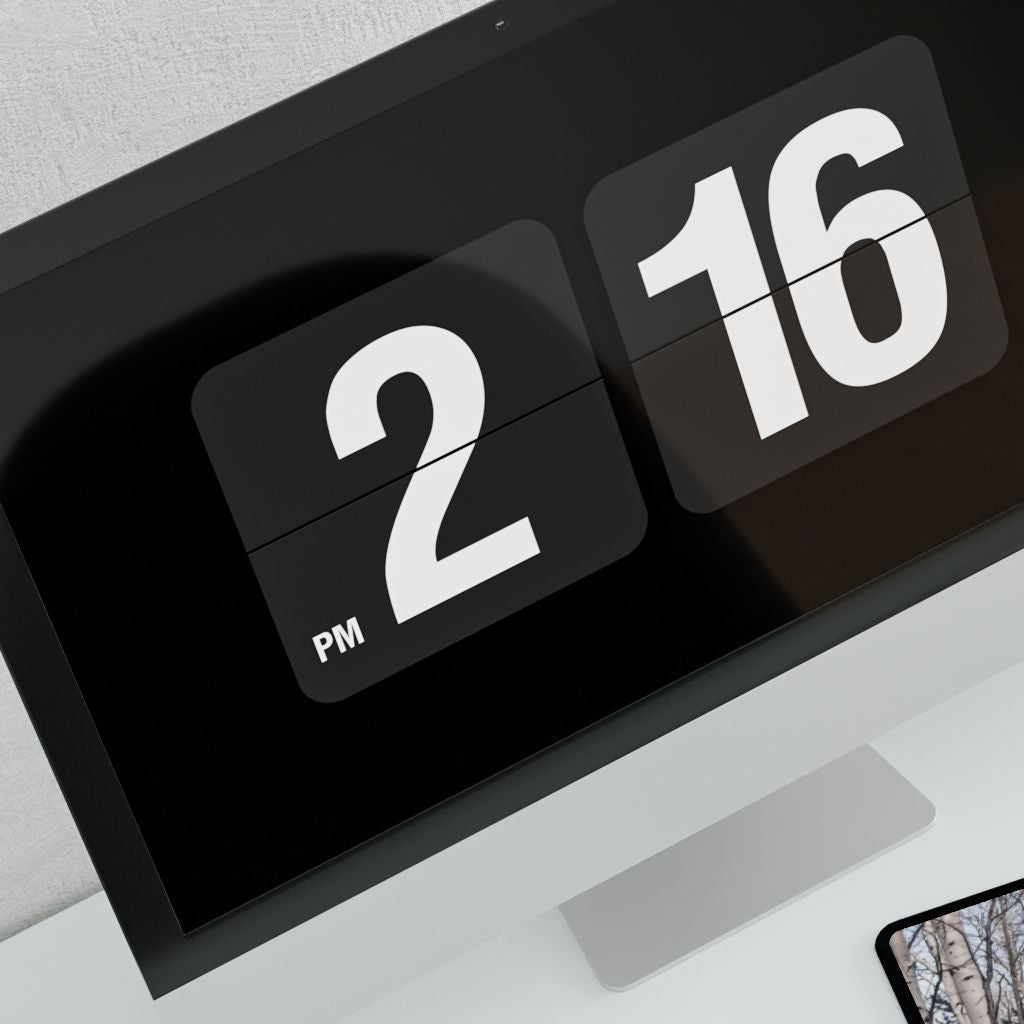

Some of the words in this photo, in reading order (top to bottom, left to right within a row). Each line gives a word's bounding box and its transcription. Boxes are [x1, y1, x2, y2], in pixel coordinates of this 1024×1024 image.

[326, 325, 540, 624] 2
[638, 108, 948, 440] 16
[312, 616, 365, 664] PM
